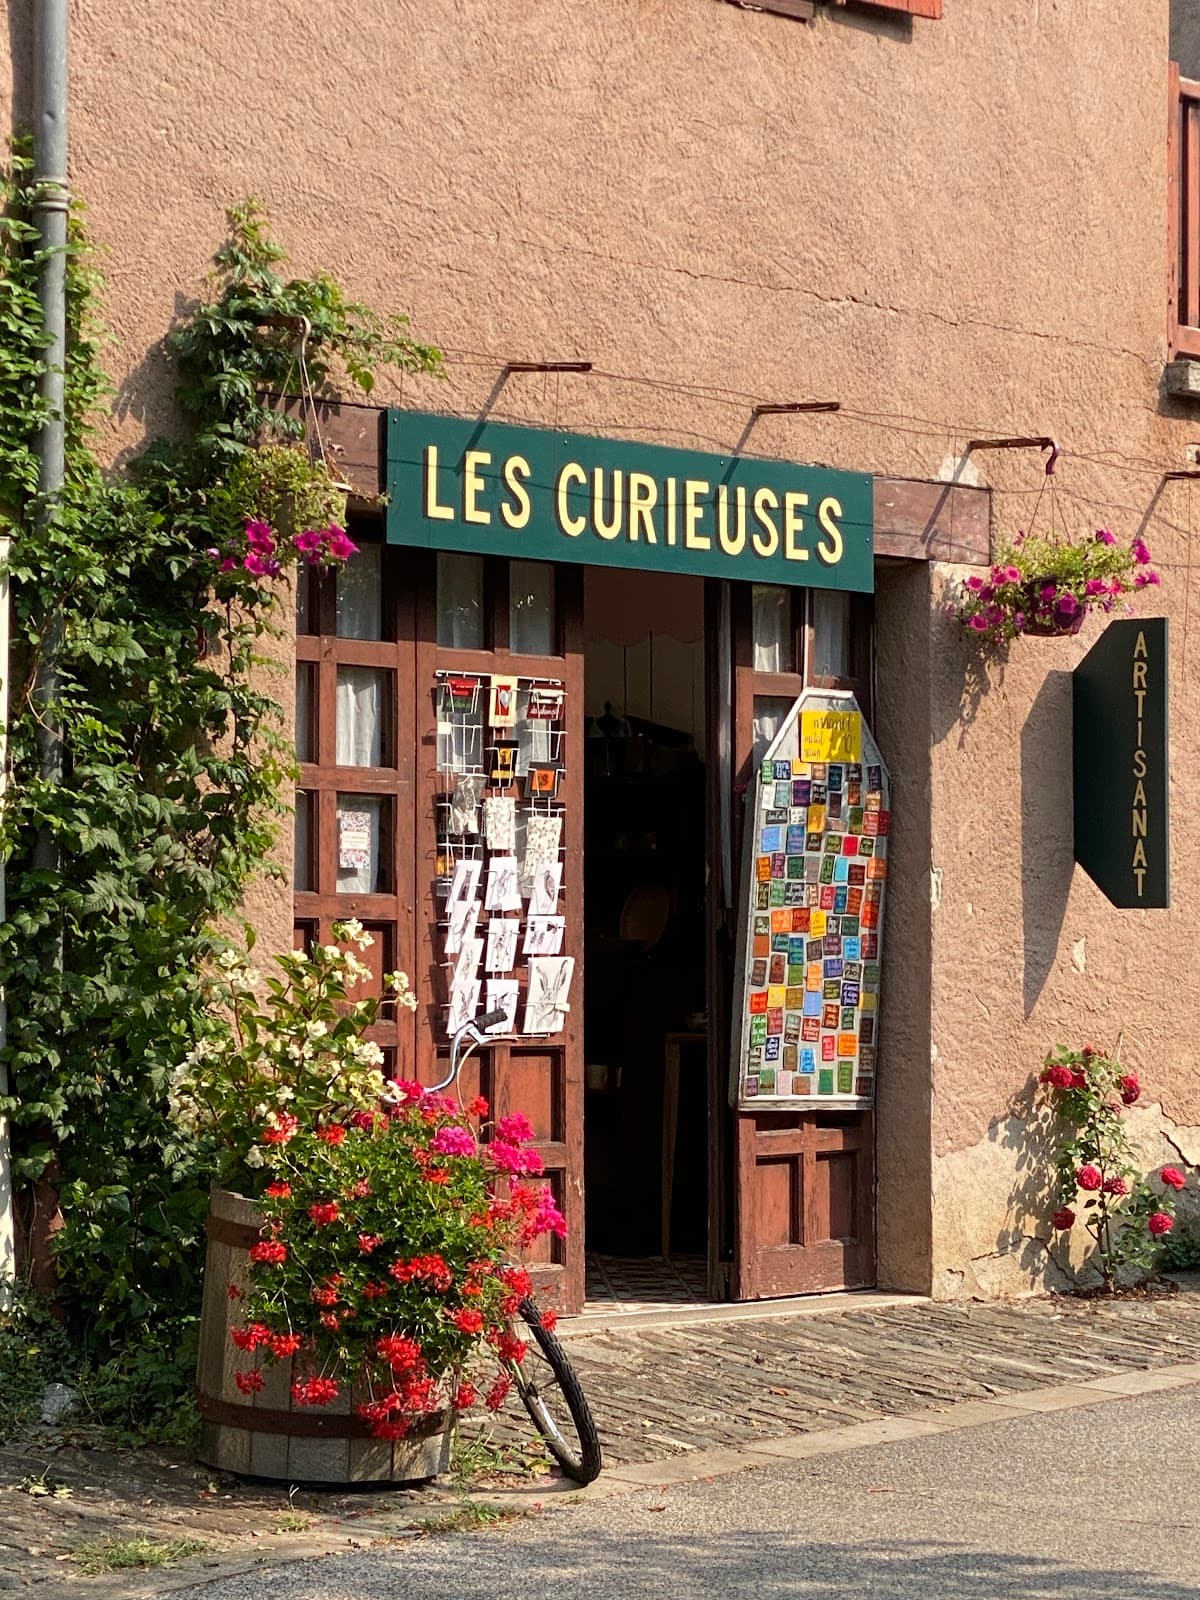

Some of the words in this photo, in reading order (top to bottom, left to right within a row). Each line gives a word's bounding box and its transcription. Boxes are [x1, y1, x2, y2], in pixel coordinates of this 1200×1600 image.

[426, 445, 532, 529] LES
[557, 462, 844, 564] CURIEUSES
[1132, 631, 1147, 897] ARTISANAT
